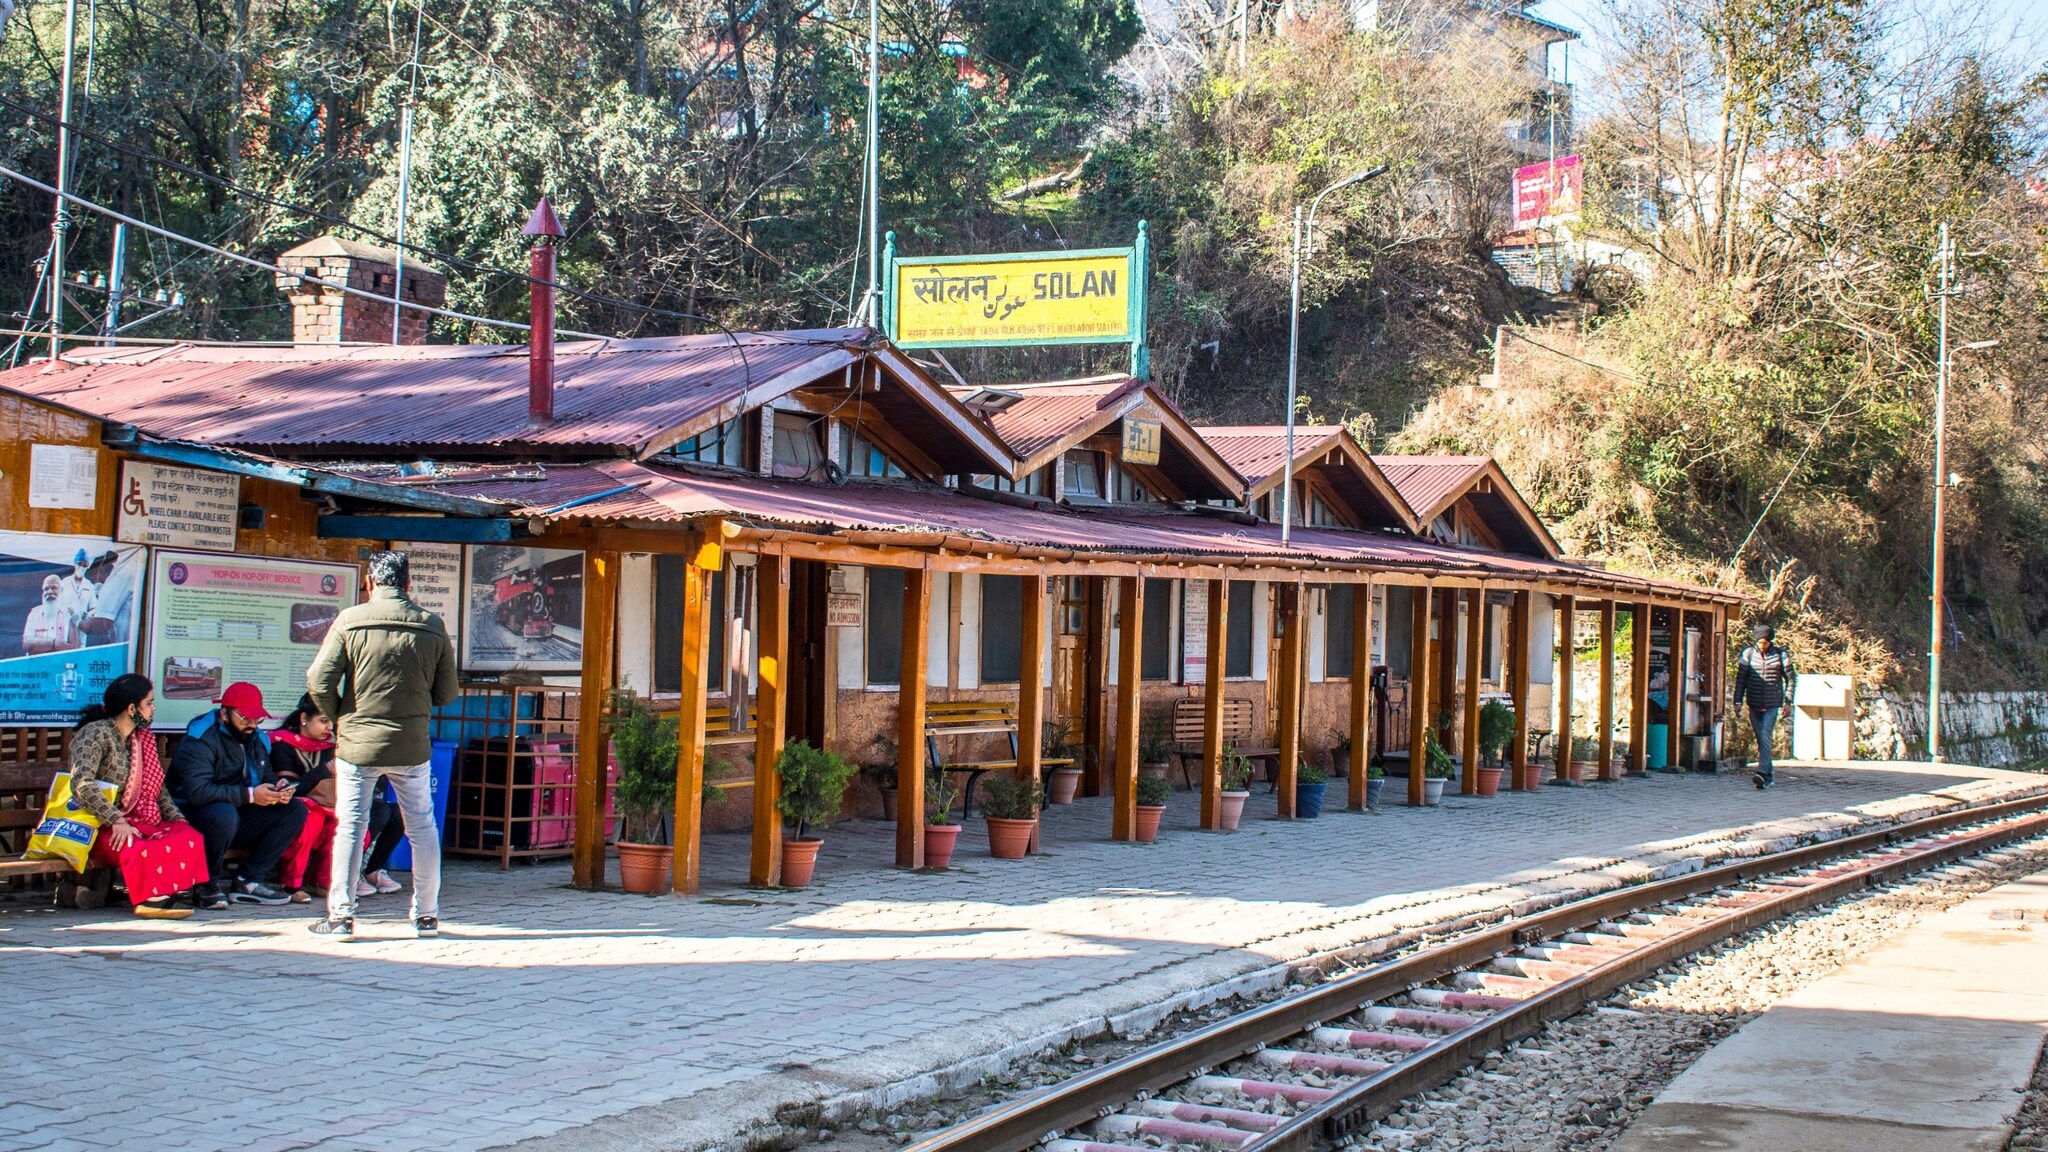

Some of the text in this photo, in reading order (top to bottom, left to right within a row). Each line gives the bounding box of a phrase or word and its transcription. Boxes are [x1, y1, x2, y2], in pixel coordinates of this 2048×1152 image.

[911, 267, 998, 304] सोलन
[1033, 269, 1117, 300] SOLAN
[980, 327, 999, 336] 1494
[1077, 322, 1095, 333] ABOVE
[1096, 322, 1107, 332] SEA
[149, 506, 166, 517] WHEEL
[166, 508, 182, 518] CHAIR
[182, 509, 188, 518] IS
[188, 509, 217, 522] AVAILABLE
[148, 519, 168, 530] PLEASE
[167, 520, 192, 532] CONTACT
[192, 523, 213, 534] STATION
[146, 532, 155, 541] ON
[274, 574, 302, 584] SERVICE
[829, 611, 860, 623] NO ADMISSION
[7, 711, 14, 720] के
